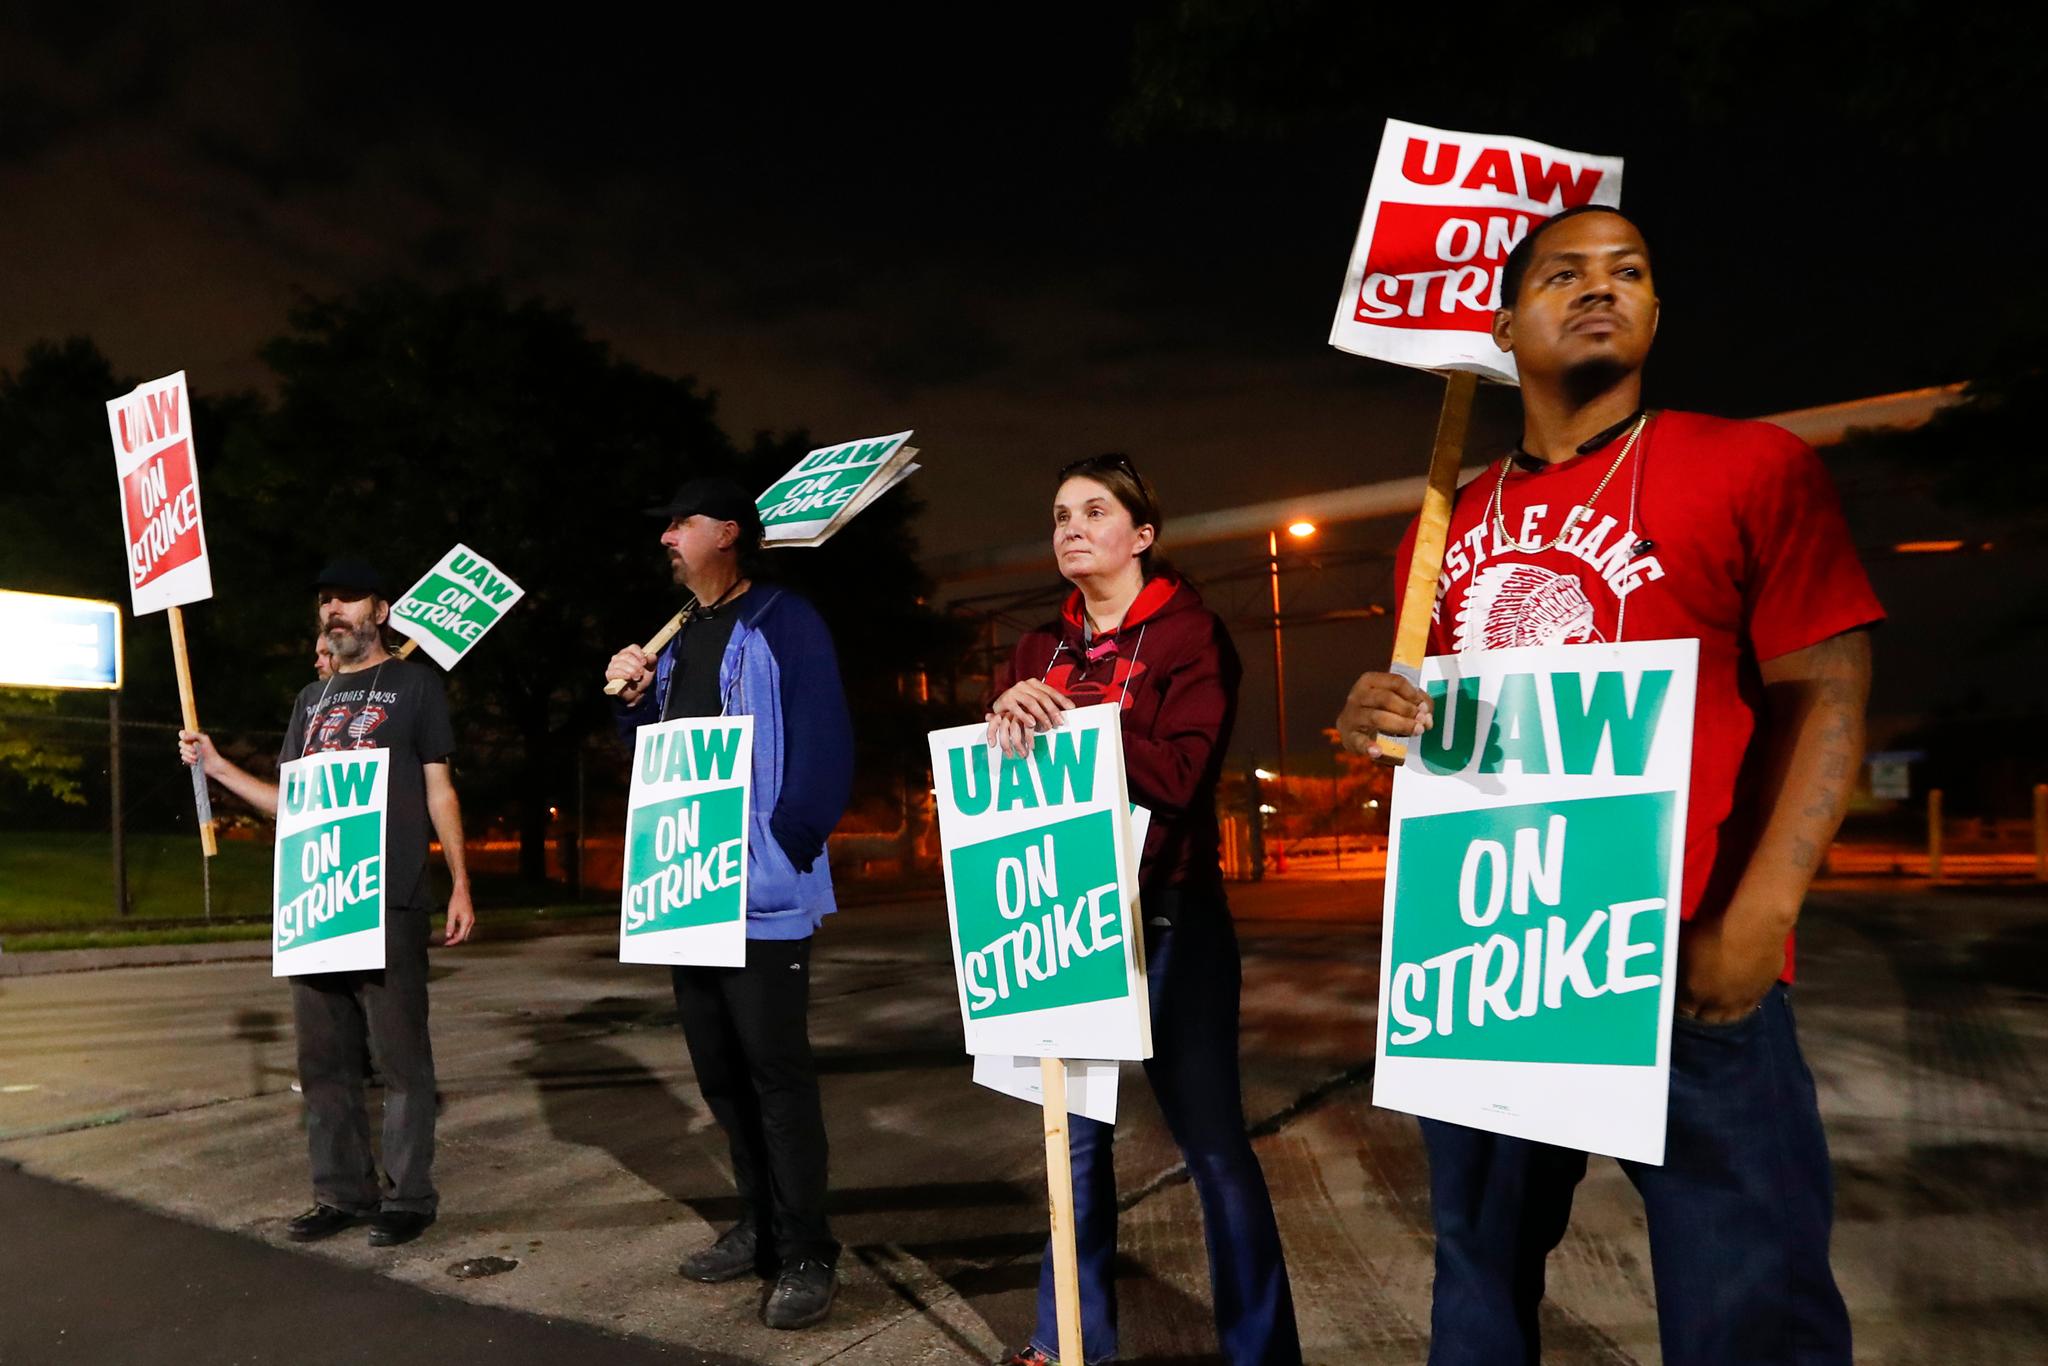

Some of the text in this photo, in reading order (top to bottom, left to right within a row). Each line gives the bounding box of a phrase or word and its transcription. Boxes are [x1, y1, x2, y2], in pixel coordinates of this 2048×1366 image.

[1402, 137, 1604, 208] UAW
[1435, 215, 1529, 263] ON
[1359, 265, 1502, 319] STRI
[118, 386, 180, 454] UAW
[784, 471, 843, 499] ON
[799, 438, 901, 472] UAW
[141, 458, 167, 518] ON
[759, 484, 863, 521] TRIKE
[131, 484, 198, 583] STRIKE
[1555, 504, 1665, 599] GANG
[437, 587, 477, 613] ON
[449, 552, 514, 605] UAW
[396, 597, 484, 642] STRIKE
[367, 690, 397, 704] 94/95
[1420, 669, 1674, 776] UAW
[641, 728, 742, 785] UAW
[948, 727, 1100, 816] UAW
[286, 761, 379, 816] UAW
[302, 825, 340, 883] ON
[655, 801, 700, 862] ON
[627, 838, 742, 930] STRIKE
[996, 834, 1058, 919] ON
[1459, 814, 1567, 927] ON
[279, 855, 380, 947] STRIKE
[964, 882, 1123, 1012] STRIKE
[1390, 897, 1667, 1045] STRIKE
